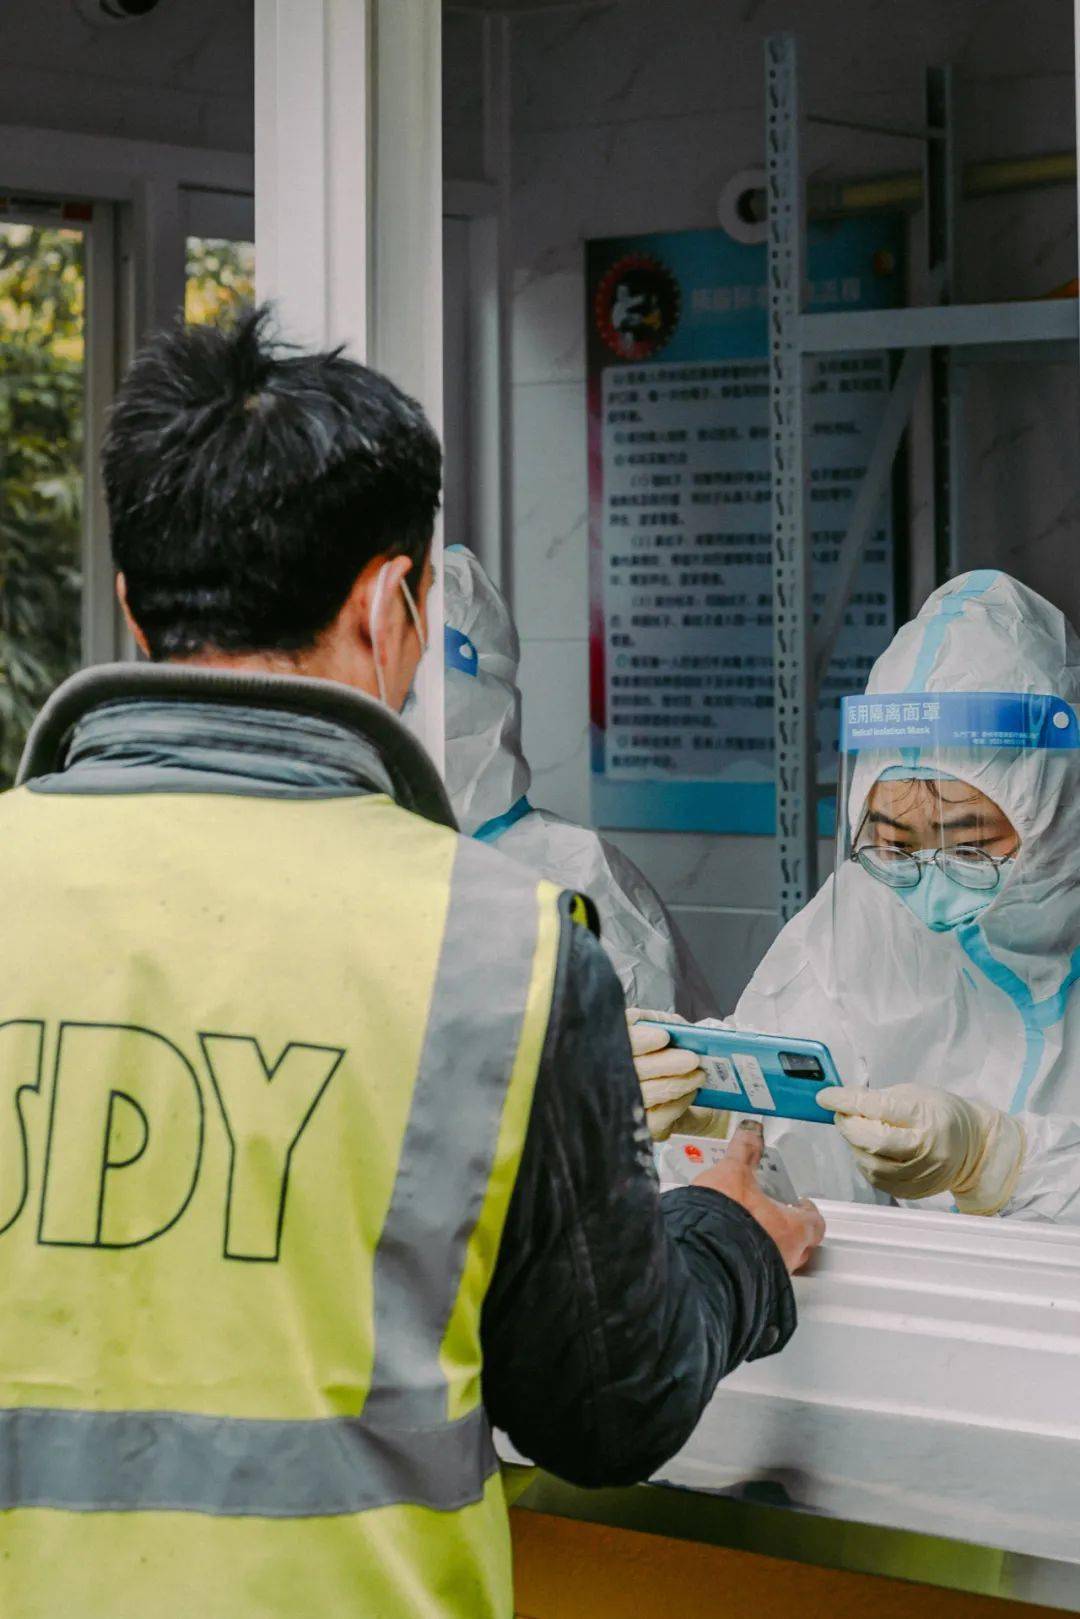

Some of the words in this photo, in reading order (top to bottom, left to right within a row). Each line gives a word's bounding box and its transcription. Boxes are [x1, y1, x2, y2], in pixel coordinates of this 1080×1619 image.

[848, 703, 940, 724] 医用隔离面罩
